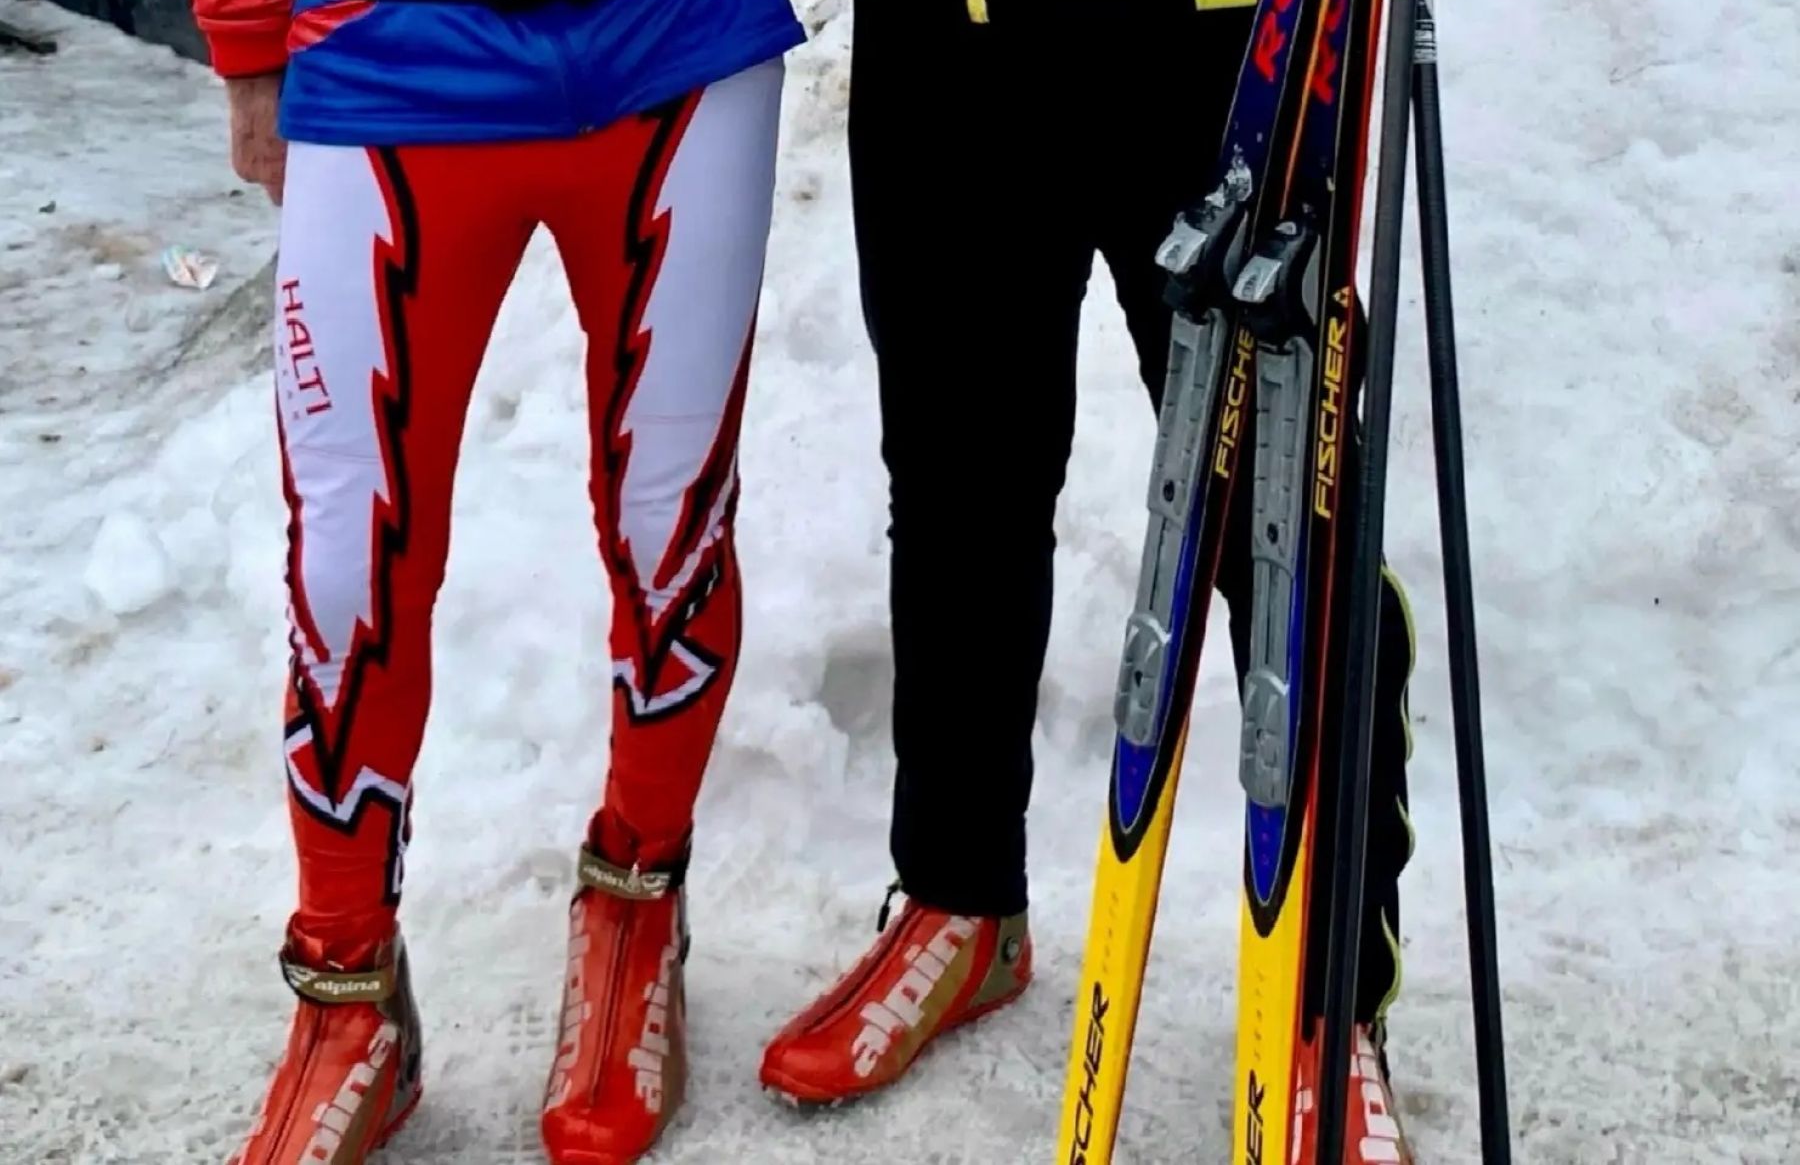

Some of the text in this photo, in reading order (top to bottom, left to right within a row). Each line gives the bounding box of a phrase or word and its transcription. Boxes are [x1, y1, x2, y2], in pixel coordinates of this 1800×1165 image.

[282, 279, 333, 417] HALTI
[1314, 317, 1347, 520] FISCHER
[313, 978, 380, 995] alpina
[852, 915, 982, 1079] alpin
